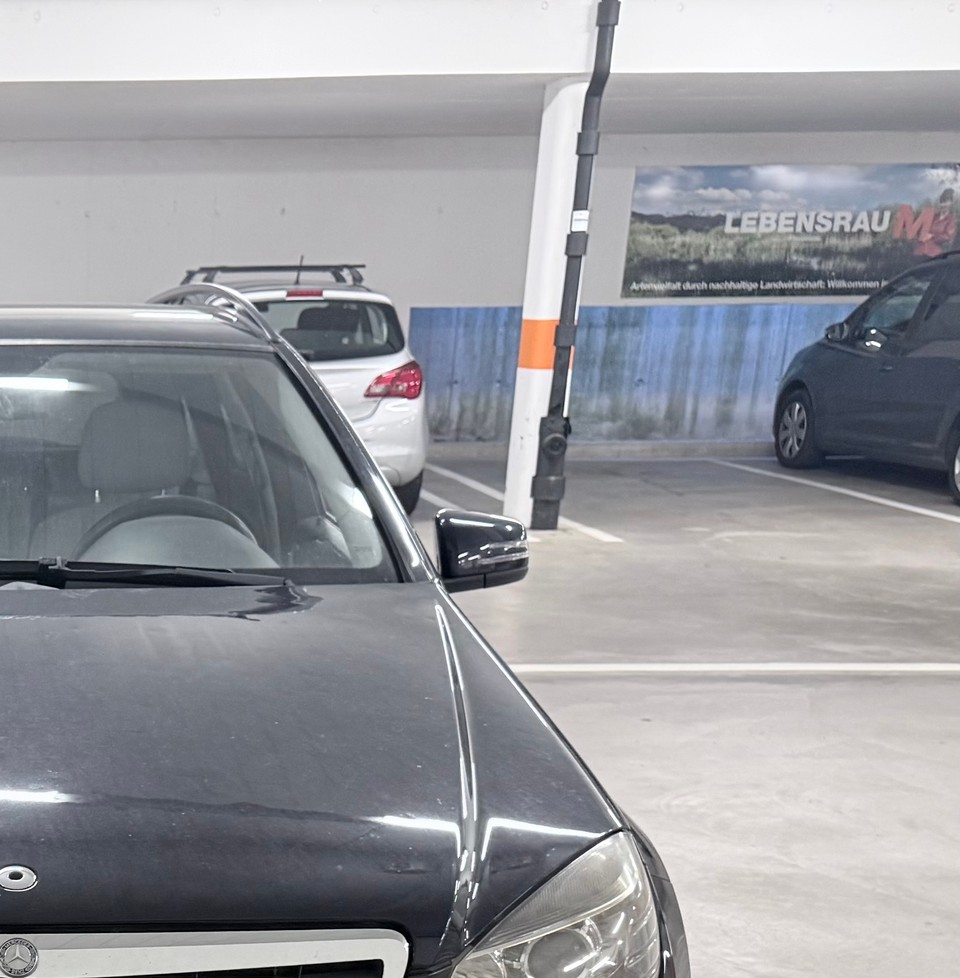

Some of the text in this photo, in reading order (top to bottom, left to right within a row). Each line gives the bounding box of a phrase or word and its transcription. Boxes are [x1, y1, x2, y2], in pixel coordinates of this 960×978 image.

[682, 281, 707, 290] durch
[708, 280, 759, 291] nachhaltige
[826, 279, 879, 289] Willkommen
